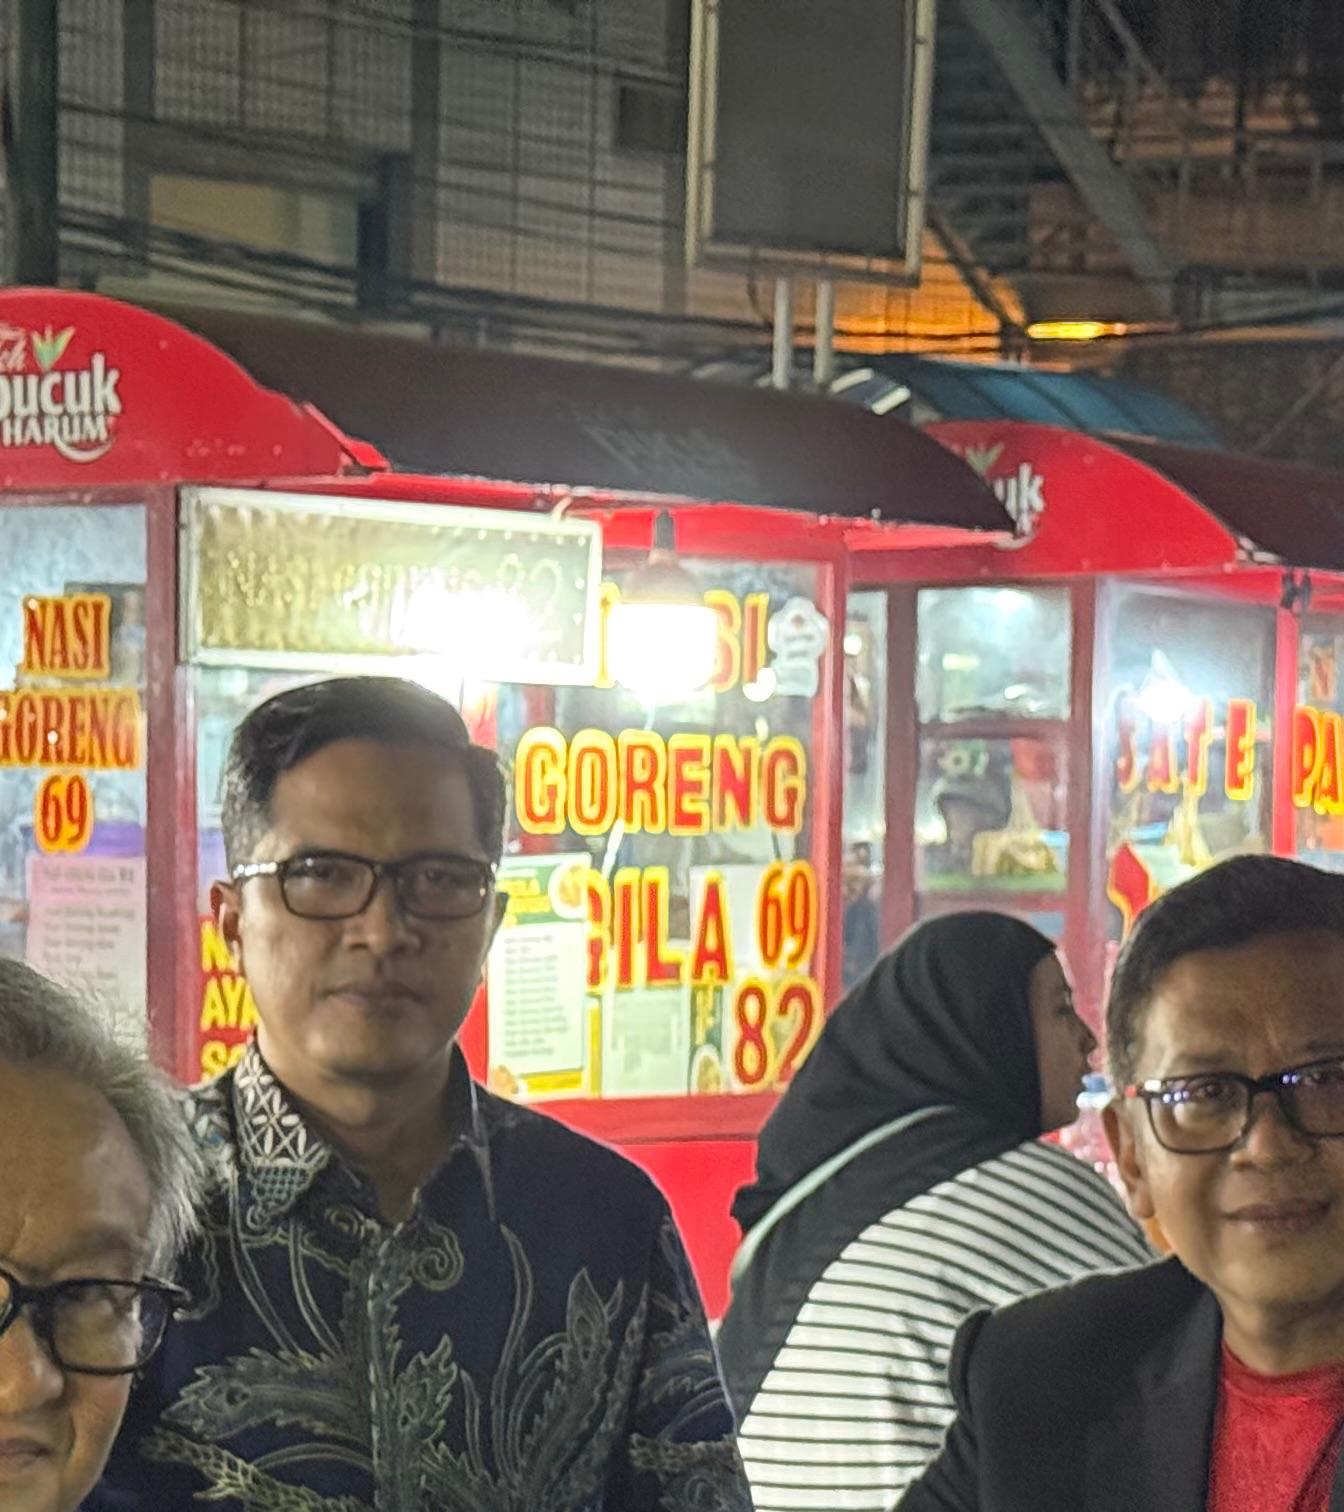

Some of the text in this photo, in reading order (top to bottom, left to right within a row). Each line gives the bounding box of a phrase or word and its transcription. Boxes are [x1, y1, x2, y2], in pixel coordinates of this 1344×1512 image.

[1, 415, 112, 455] HARUM
[23, 597, 107, 677] NASI
[36, 774, 91, 853] 69
[516, 726, 807, 835] GORENG
[757, 860, 818, 970] 69
[732, 976, 824, 1090] 82
